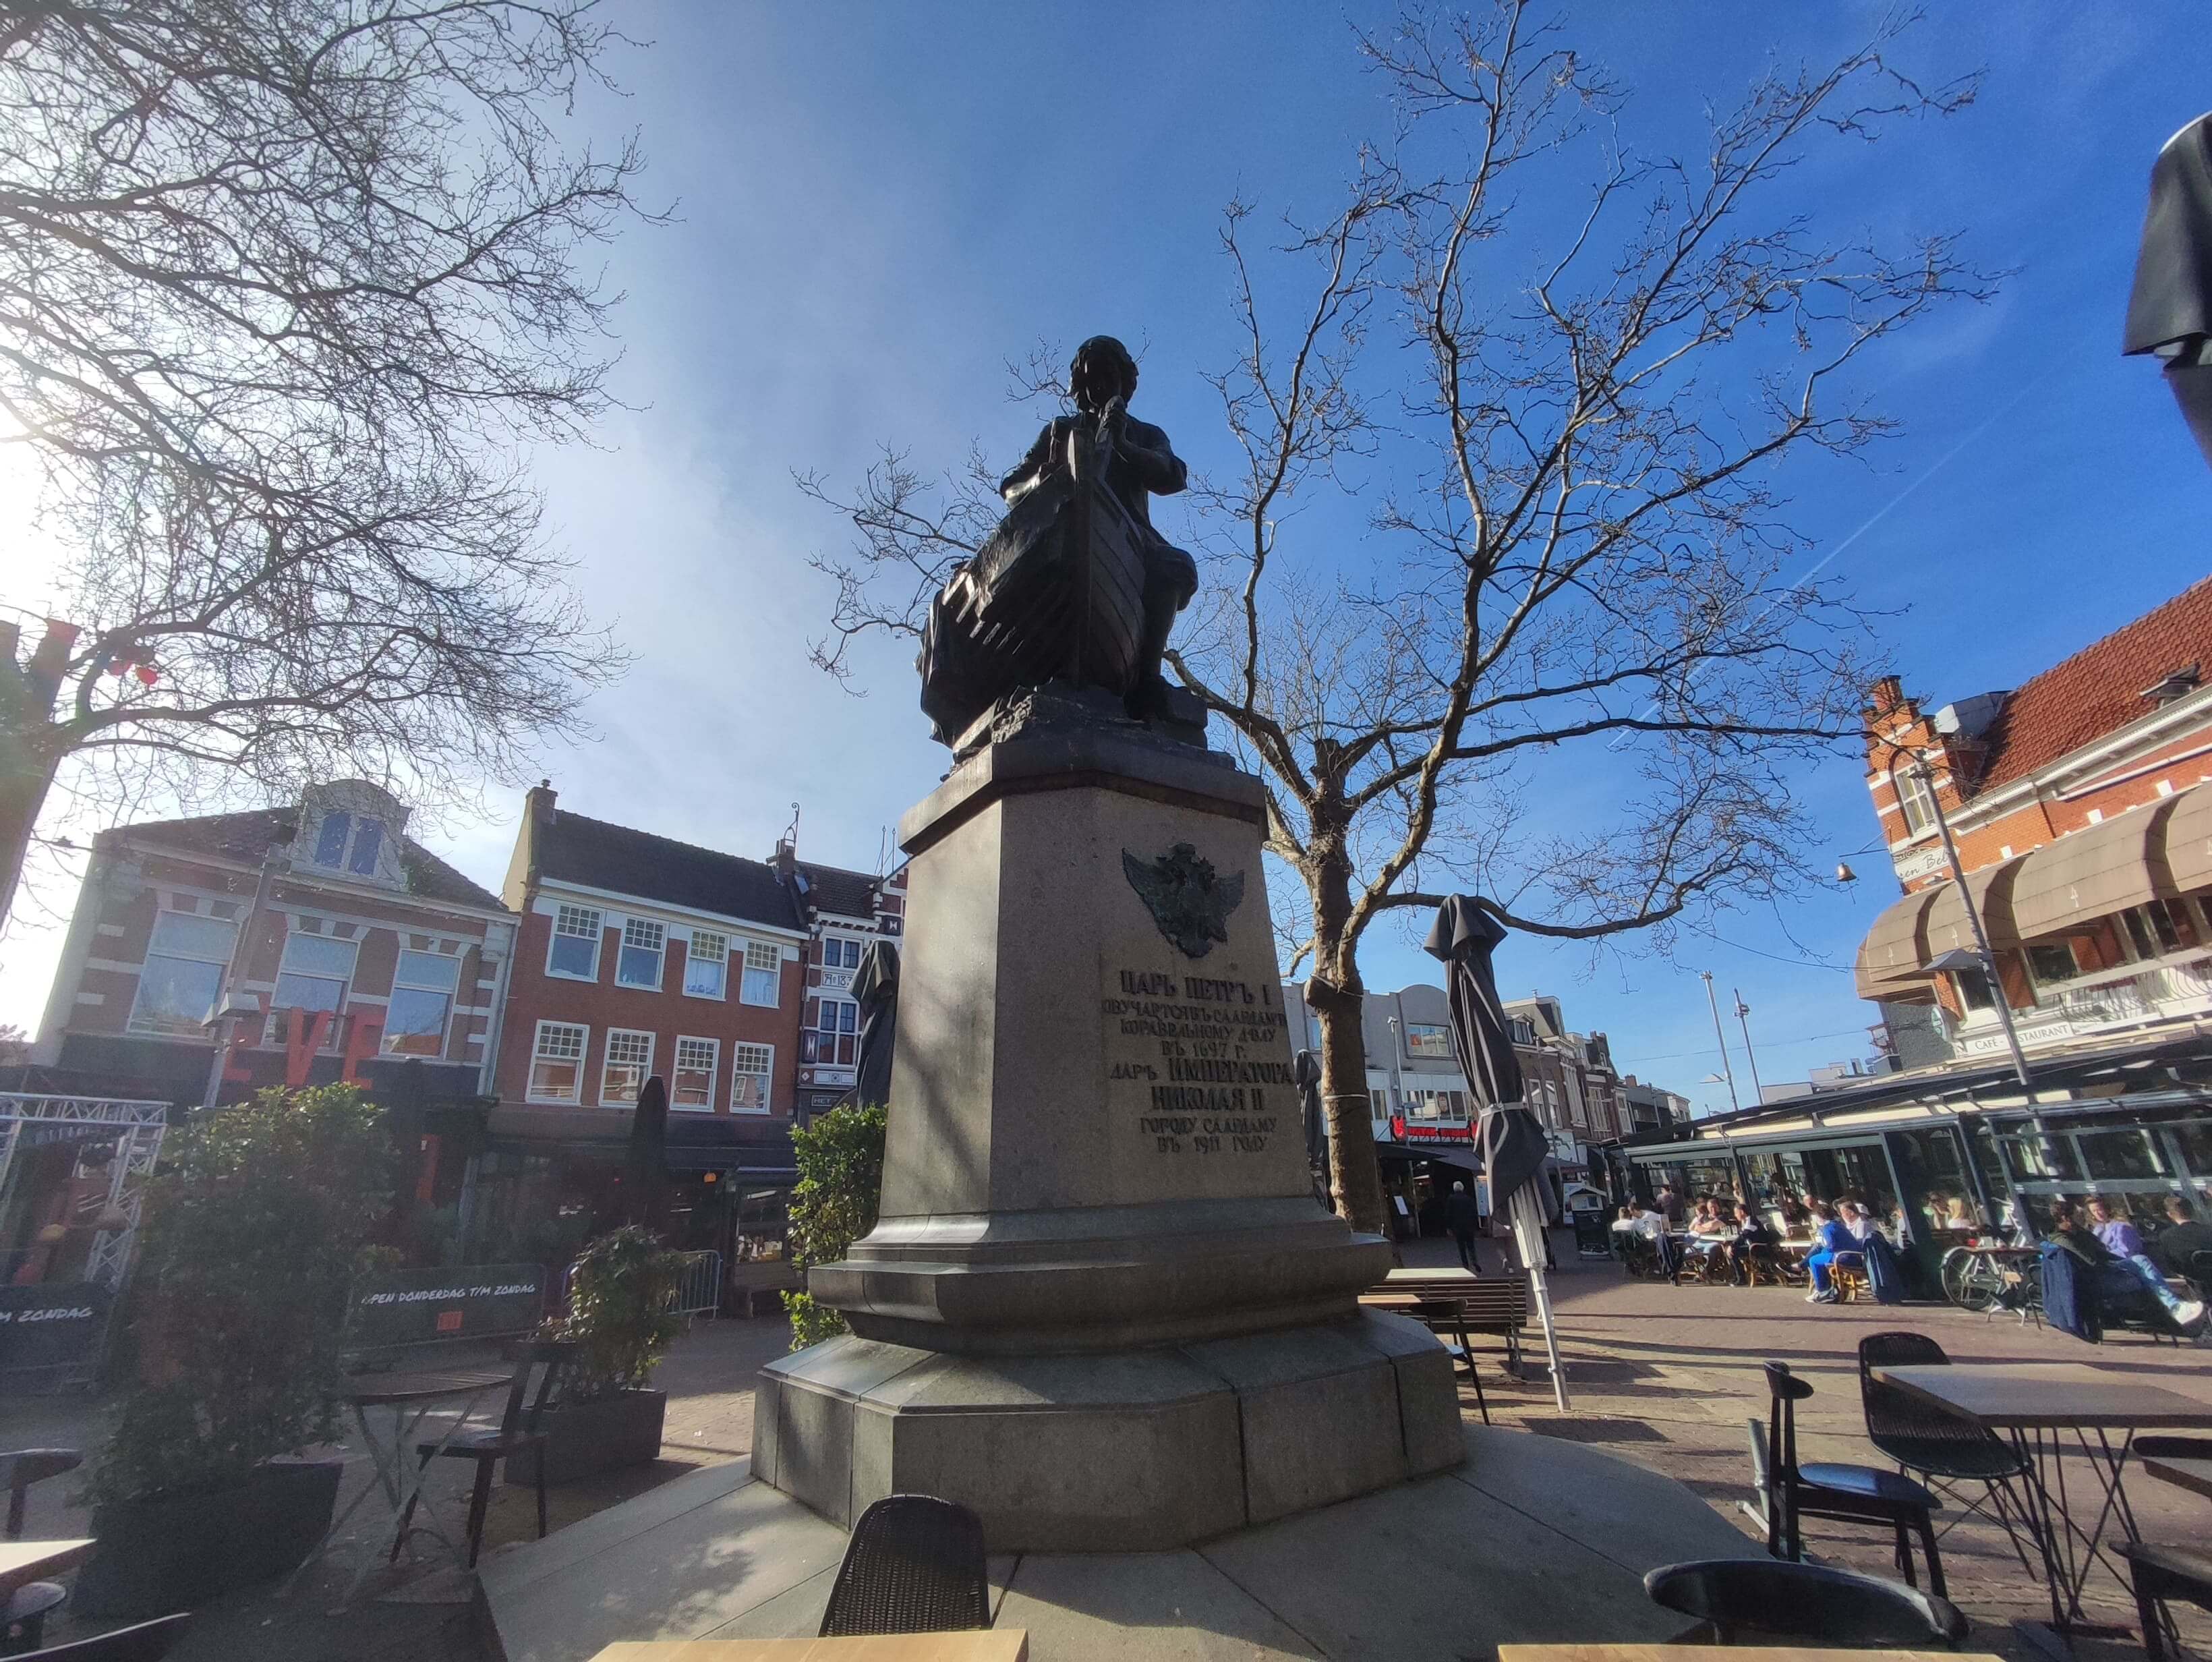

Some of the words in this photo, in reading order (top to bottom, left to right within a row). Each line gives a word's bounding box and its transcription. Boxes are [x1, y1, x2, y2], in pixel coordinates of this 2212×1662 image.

[1184, 977, 1255, 1004] ПЕТРЪ
[2016, 1024, 2069, 1042] STAURANT
[1192, 1041, 1227, 1058] 1697
[1110, 1063, 1158, 1081] ДАРЪ
[1168, 1057, 1295, 1085] ИМПЕРАТОРА
[1151, 1085, 1247, 1111] НИКОЛАЯ
[1140, 1116, 1198, 1134] ГОРОДУ
[1157, 1135, 1182, 1153] ВЪ
[1194, 1136, 1221, 1155] 1911
[398, 1288, 466, 1302] DONDERDAG
[469, 1285, 491, 1297] T/M
[494, 1284, 536, 1296] ZONDAG
[18, 1307, 92, 1323] ZONDAG
